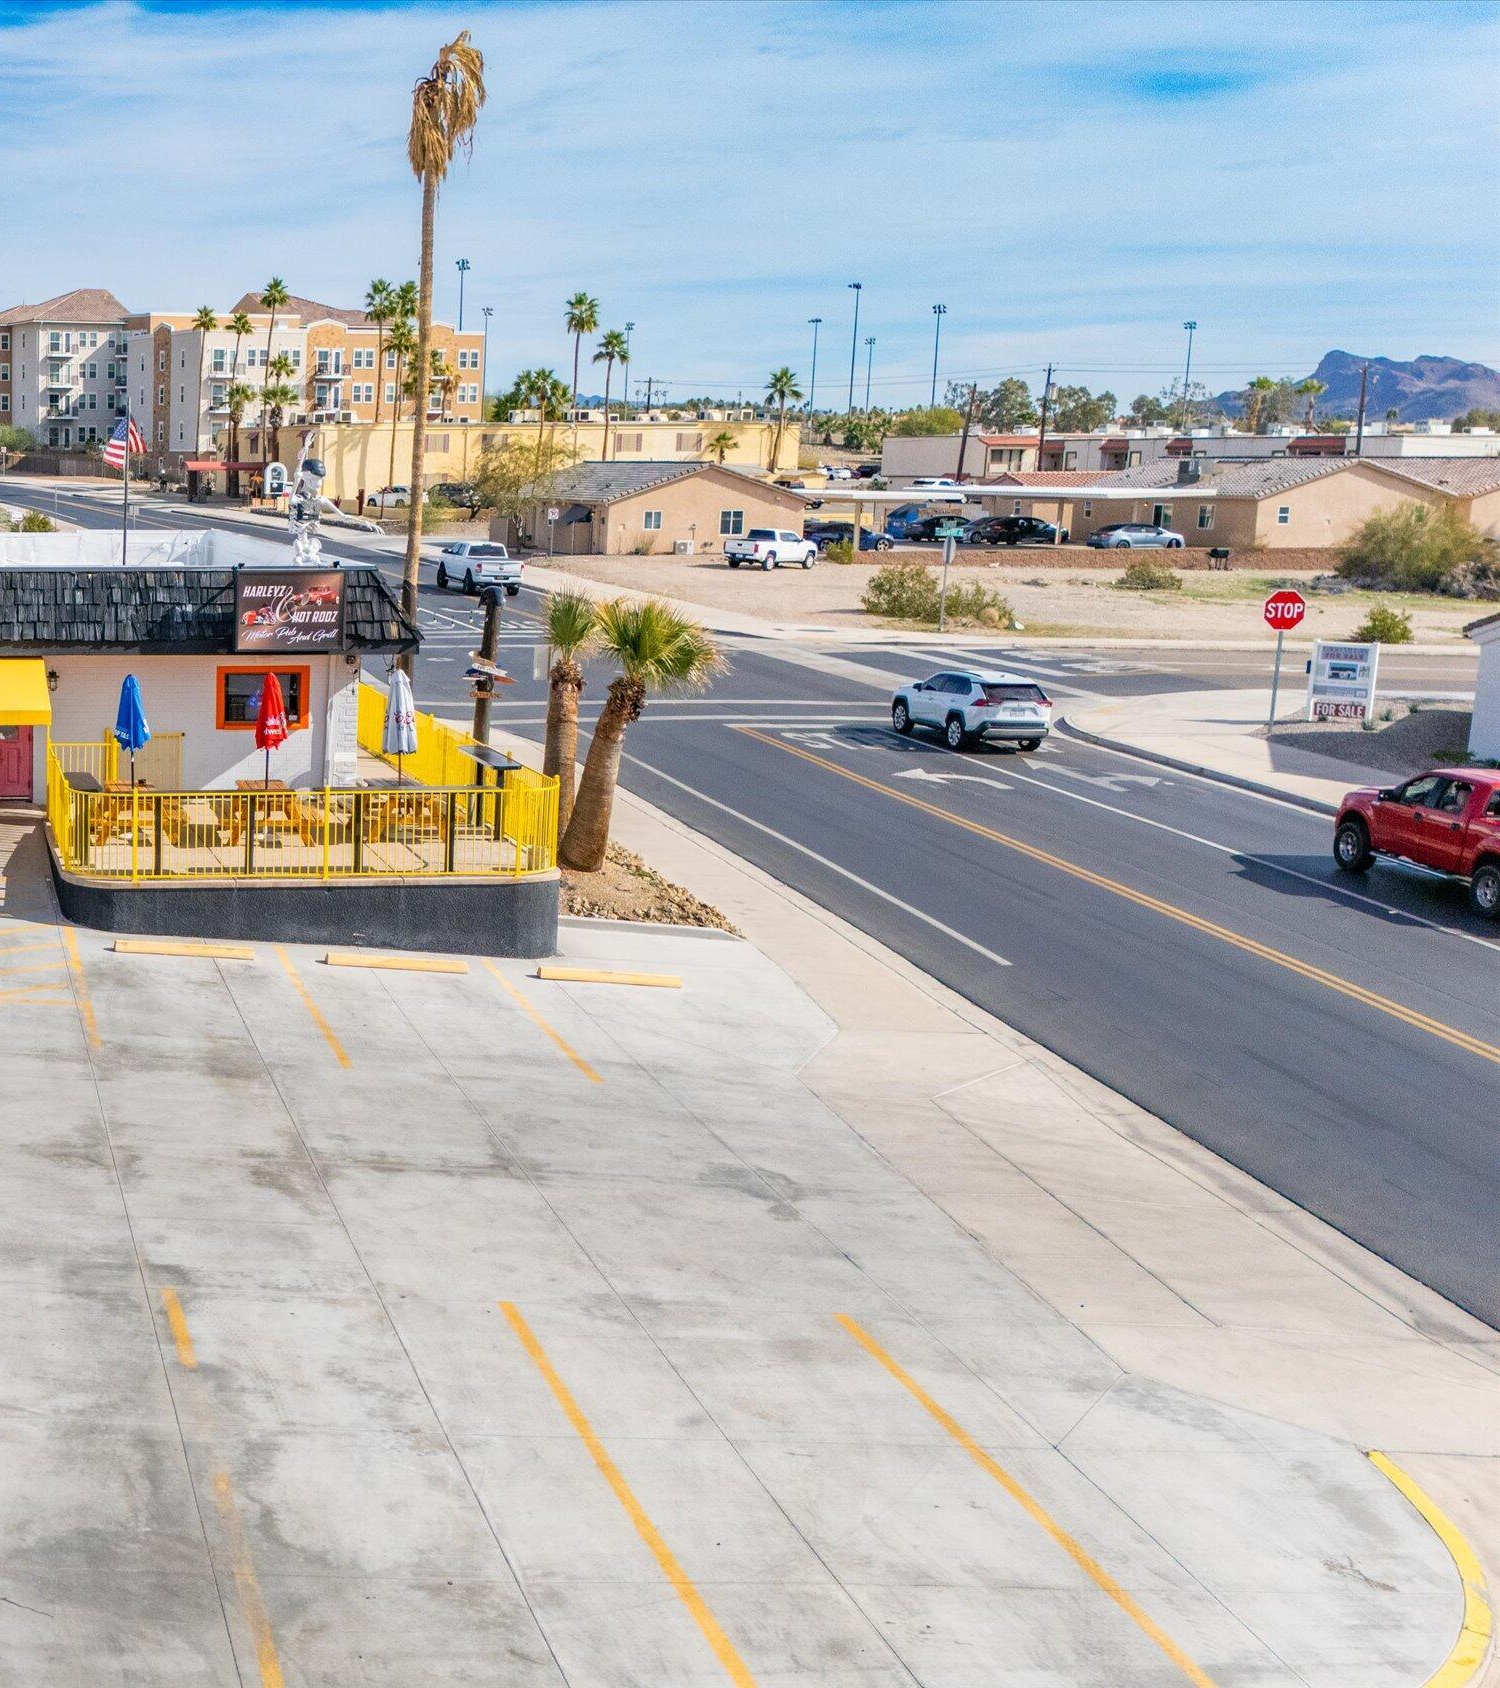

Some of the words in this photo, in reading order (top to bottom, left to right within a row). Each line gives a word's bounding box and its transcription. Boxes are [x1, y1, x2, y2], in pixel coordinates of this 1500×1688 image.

[243, 586, 286, 597] HARLEYZ
[292, 611, 311, 622] HOT
[312, 611, 338, 622] RODZ
[1266, 602, 1303, 618] STOP
[275, 626, 297, 639] Pub
[1316, 703, 1336, 715] FOR
[1338, 705, 1363, 718] SALE
